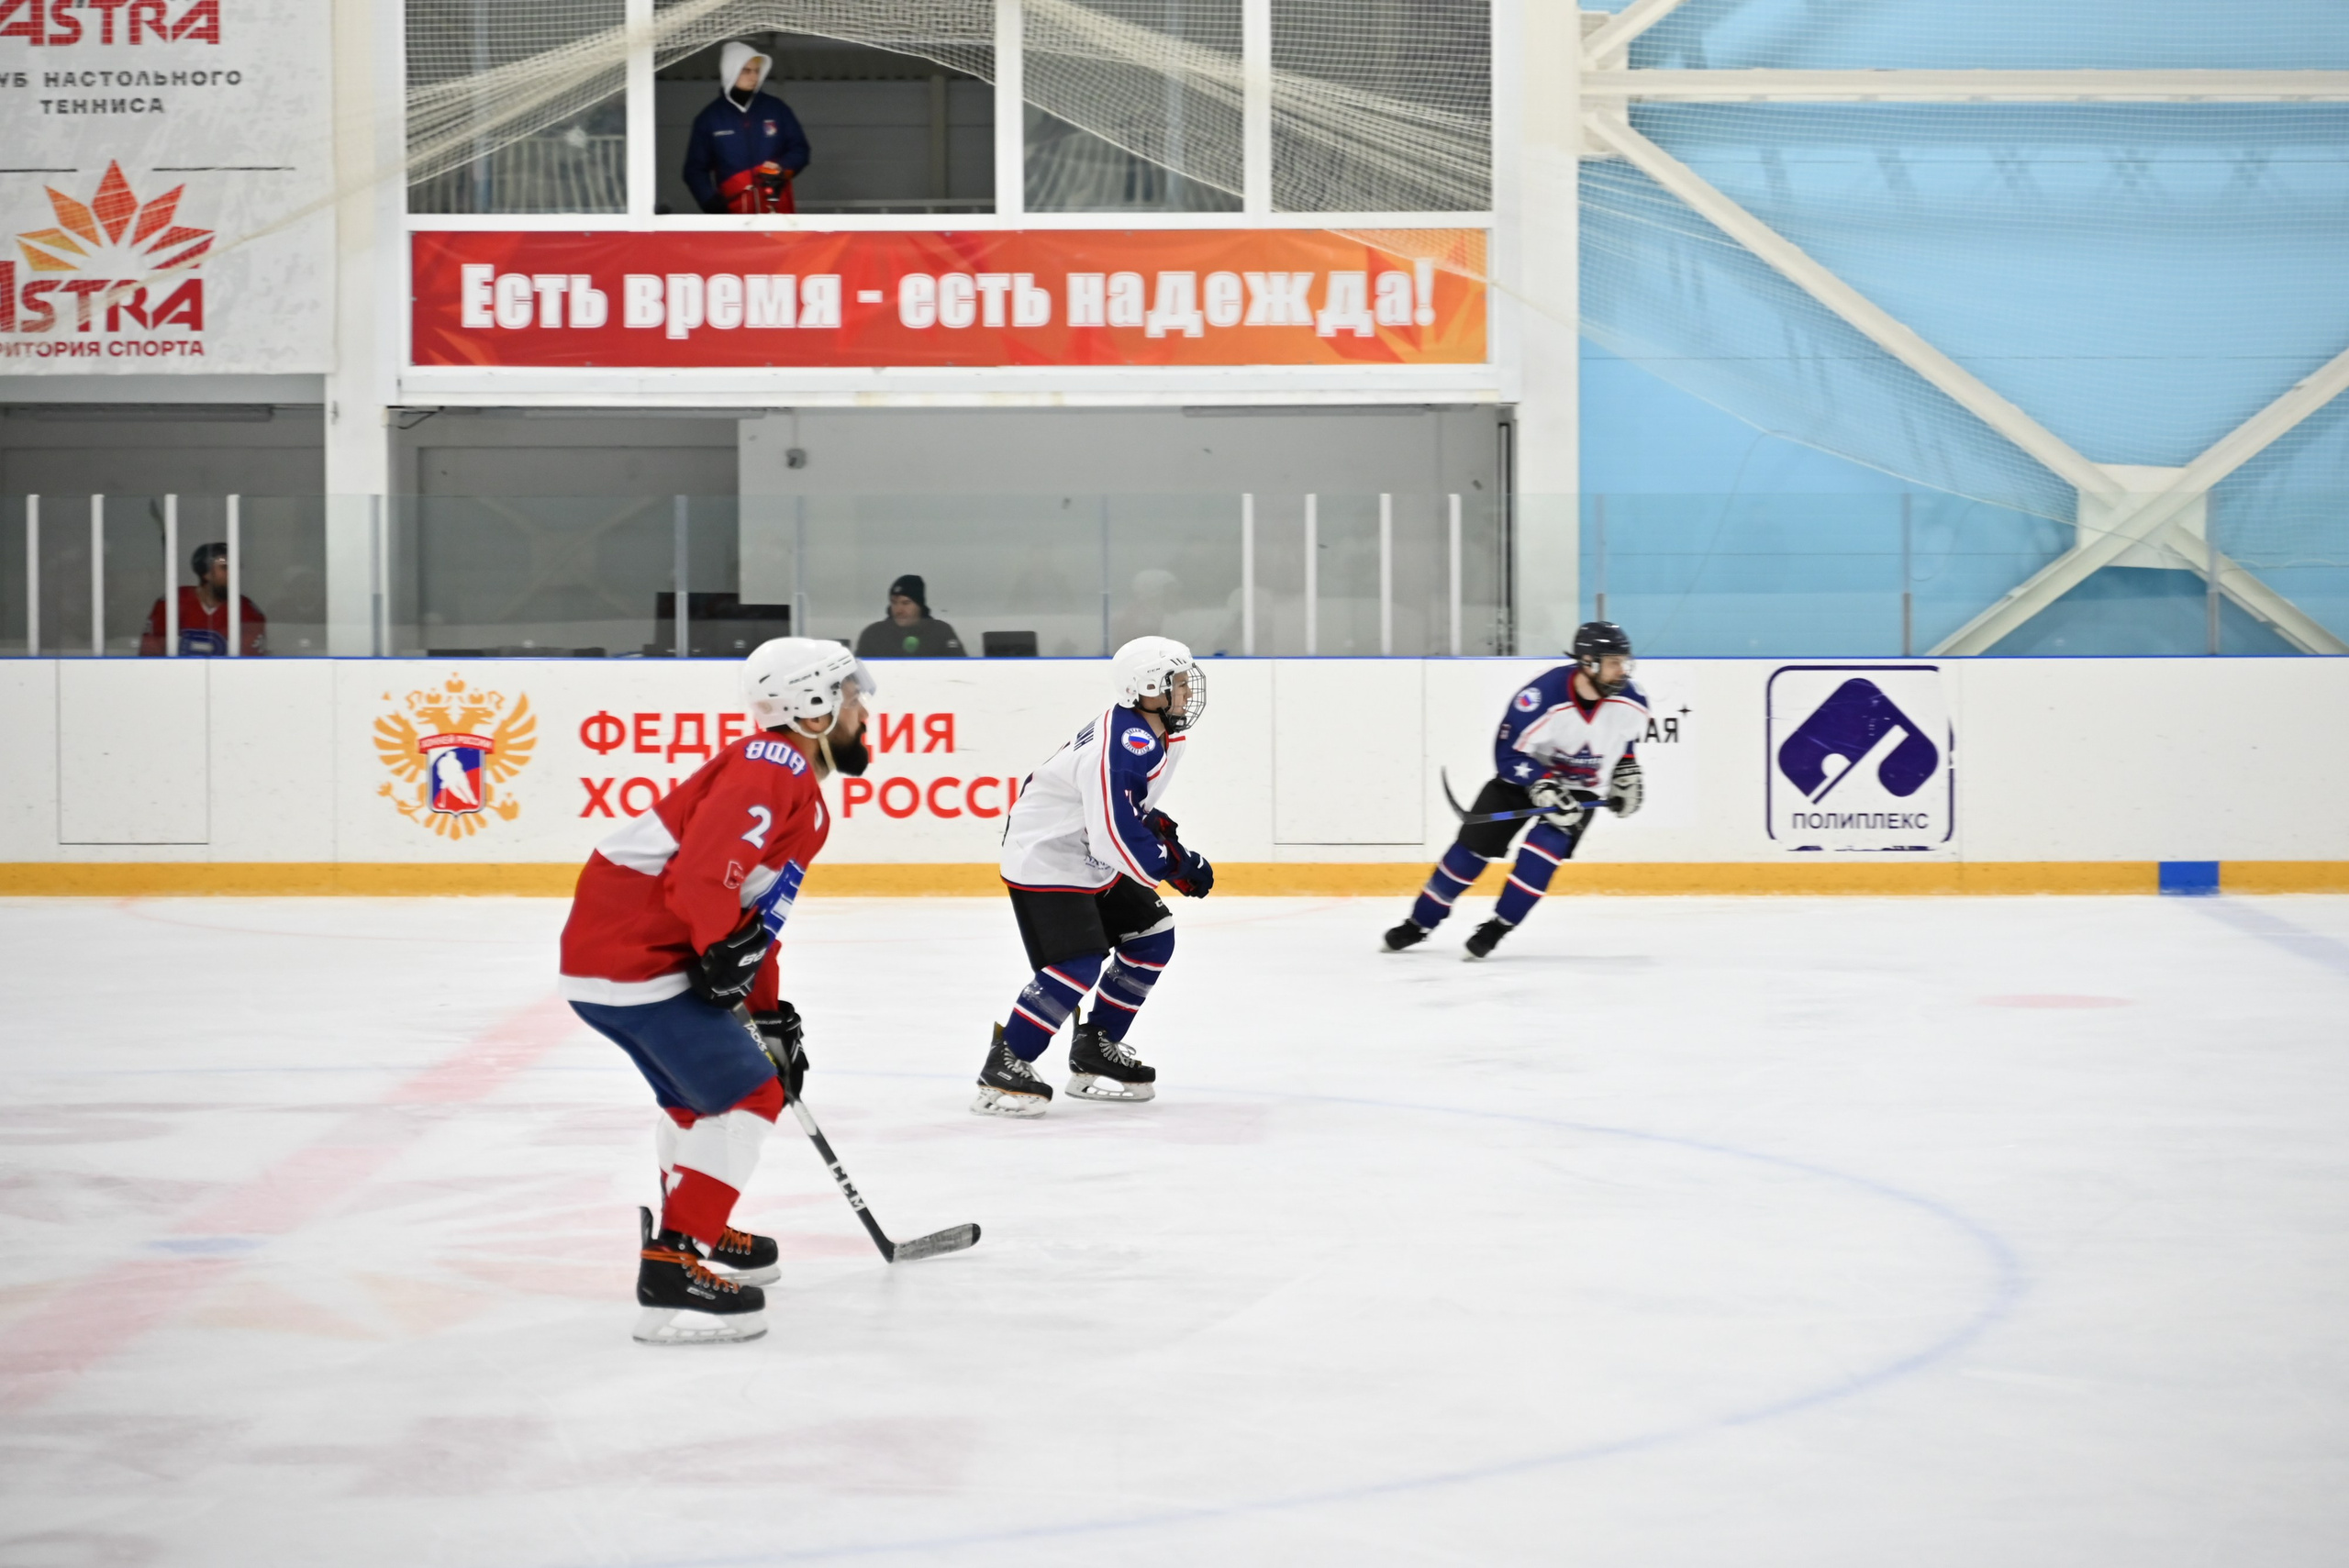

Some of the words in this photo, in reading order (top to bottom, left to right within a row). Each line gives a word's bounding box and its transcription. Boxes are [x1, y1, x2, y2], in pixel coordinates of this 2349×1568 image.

[44, 71, 242, 87] НАСТОЛЬНОГО
[40, 97, 166, 115] ТЕННИСА
[461, 263, 608, 329] Есть
[624, 272, 841, 339] время
[857, 289, 884, 303] -
[898, 272, 1052, 329] есть
[1067, 257, 1436, 338] надежда!
[0, 341, 100, 357] ИТОРИЯ
[108, 340, 205, 356] СПОРТА
[579, 710, 955, 763] ФЕДЕИЯ
[842, 776, 1019, 818] РОСС
[740, 805, 773, 850] 2
[1792, 813, 1929, 829] ПОЛИПЛЕКС
[827, 1162, 866, 1211] CCM
